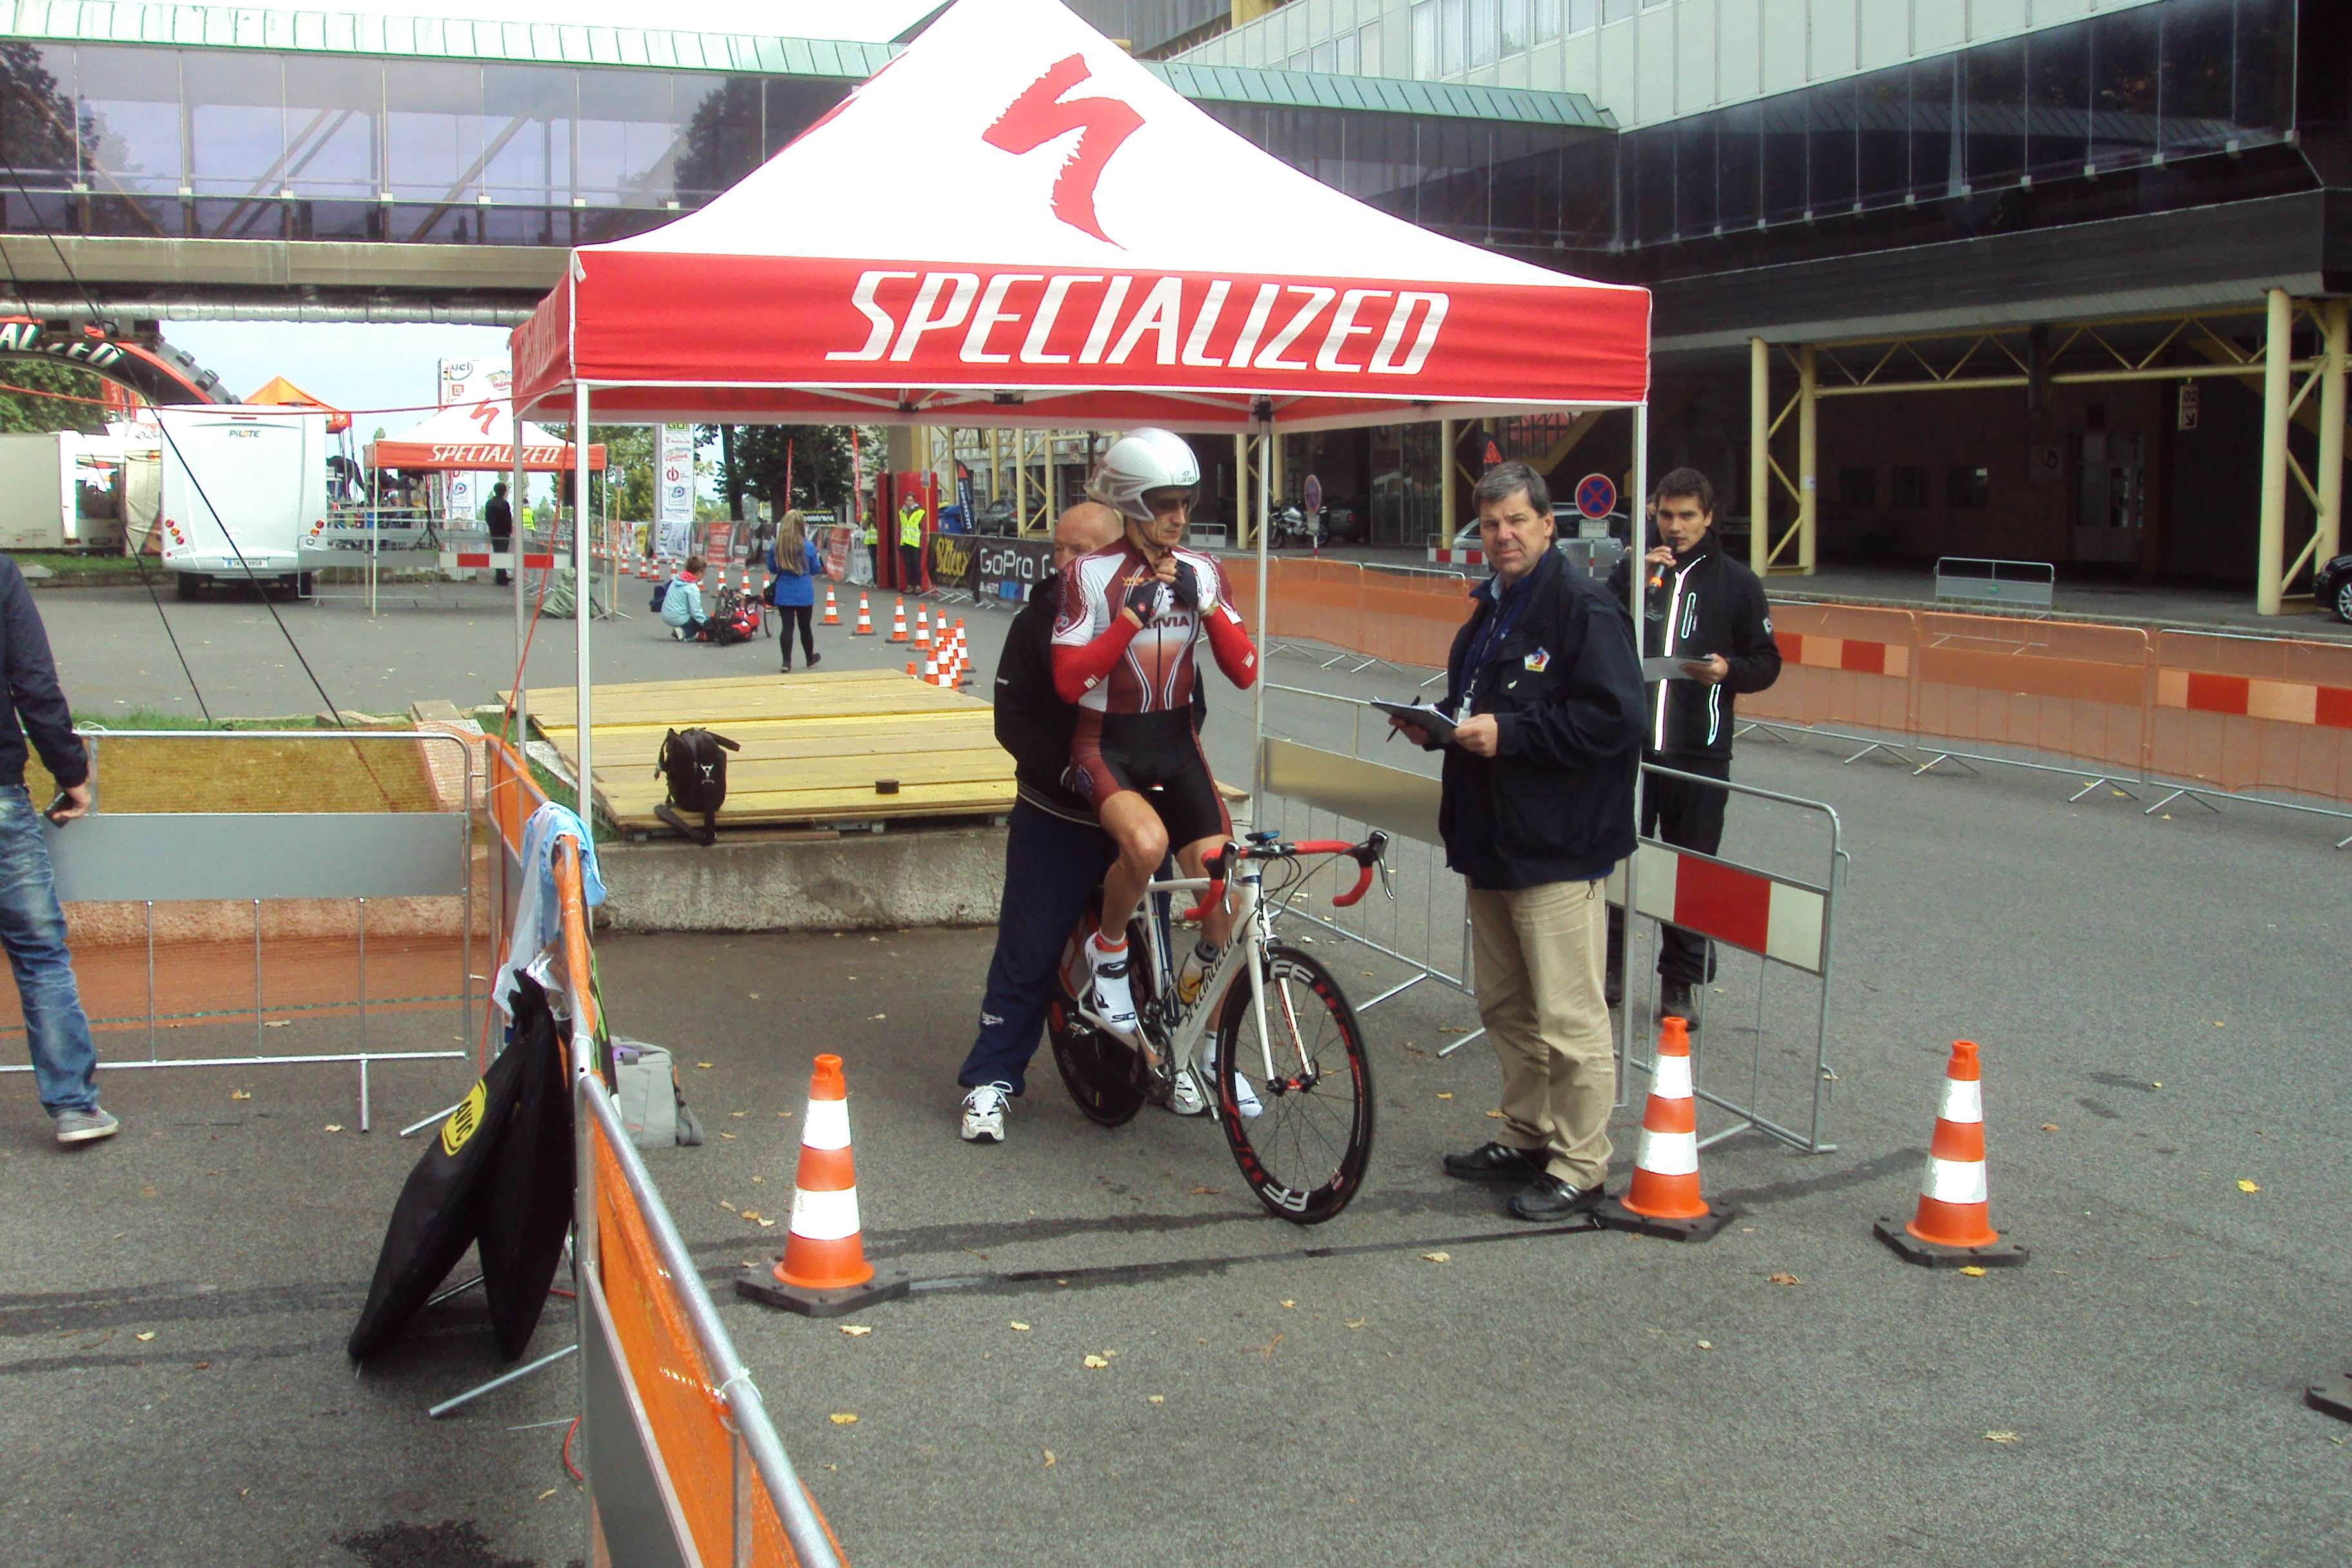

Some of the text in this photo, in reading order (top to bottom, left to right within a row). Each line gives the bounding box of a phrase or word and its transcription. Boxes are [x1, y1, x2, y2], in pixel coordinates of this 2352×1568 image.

[825, 270, 1449, 375] SPECIALIZED
[427, 445, 560, 464] SPECIALZED
[980, 548, 1033, 579] GoPro
